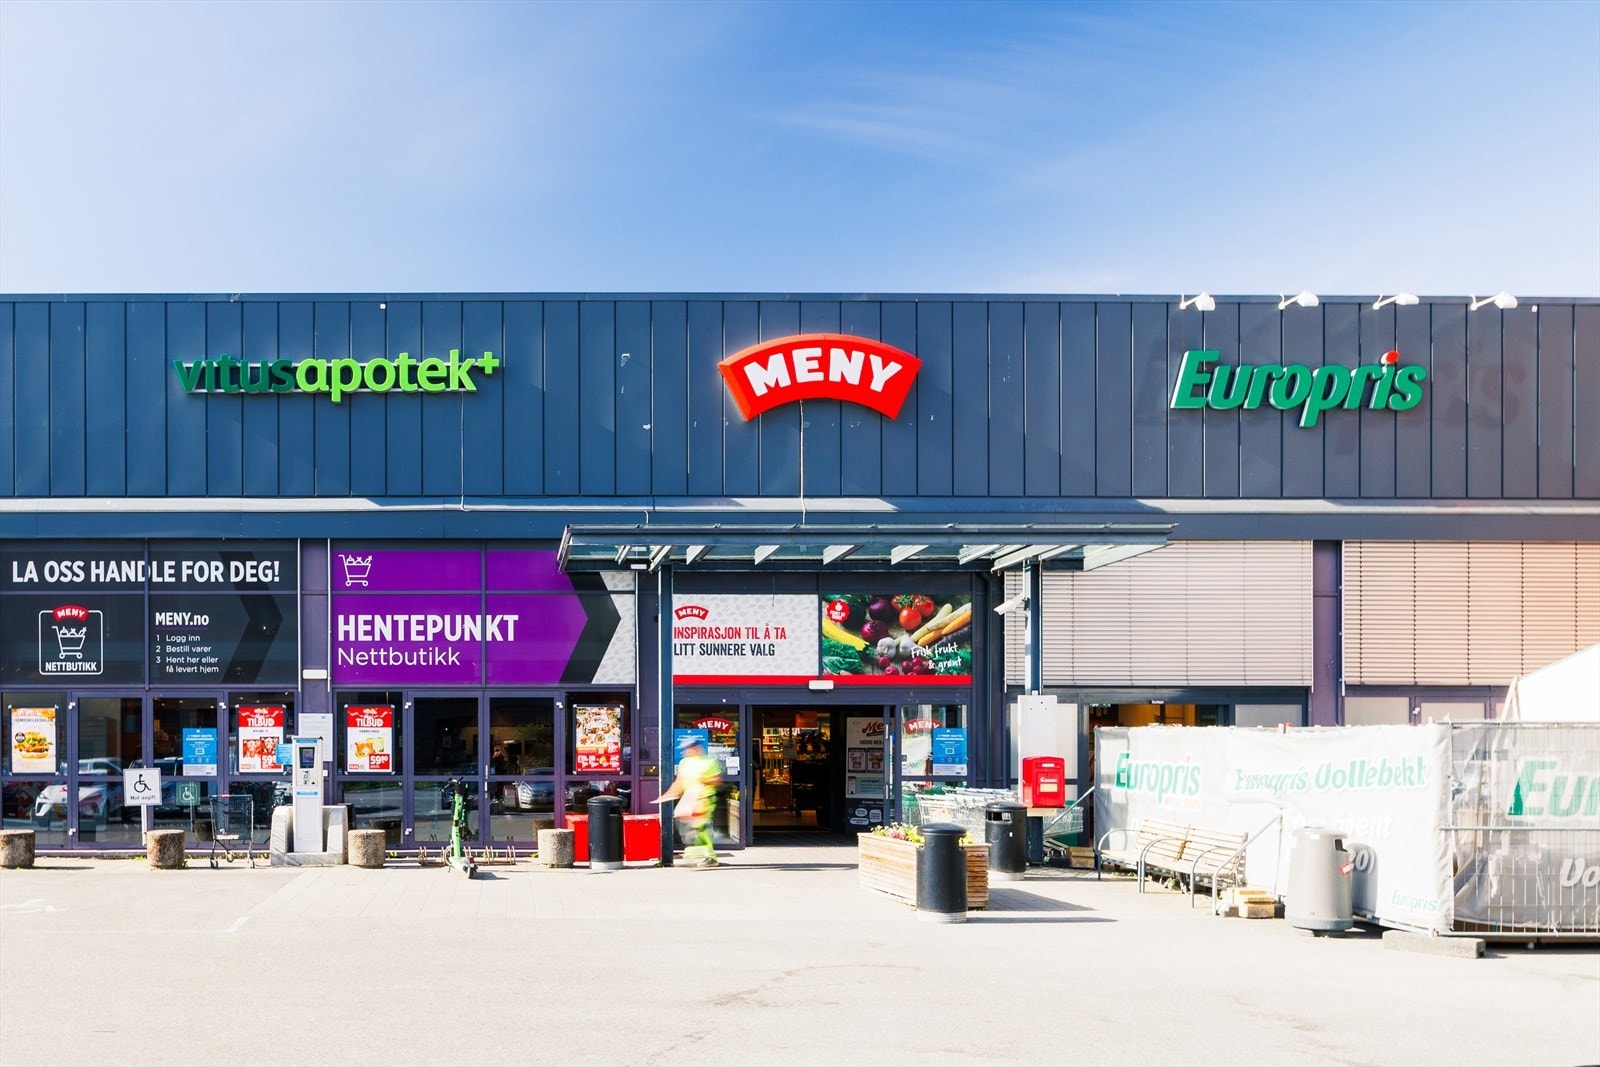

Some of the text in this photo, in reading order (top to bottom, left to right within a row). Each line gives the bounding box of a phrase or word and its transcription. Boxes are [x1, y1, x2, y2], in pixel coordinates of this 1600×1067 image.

[743, 347, 903, 397] MENY
[1170, 350, 1427, 428] Europris
[13, 561, 280, 583] LA OSS HANDLE FOR DEG!
[56, 608, 86, 619] MENY
[155, 612, 209, 626] MENY.no
[679, 607, 706, 618] MENY
[338, 615, 519, 642] HENTEPUNKT
[674, 623, 787, 640] INSPIRASJON TIL Å TA
[166, 635, 186, 643] Logg
[188, 634, 200, 642] inn
[338, 647, 461, 666] Nettbutikk
[674, 643, 775, 656] LITT SUNNERE VALG
[910, 642, 958, 658] Frisk frukt
[45, 661, 97, 671] NETTBUTIKK
[156, 656, 161, 664] 3
[928, 656, 962, 672] & grønt
[166, 664, 173, 672] få
[199, 665, 219, 674] hjem
[697, 720, 729, 730] MENY
[1115, 753, 1201, 805] Europris
[1391, 889, 1438, 912] Europris
